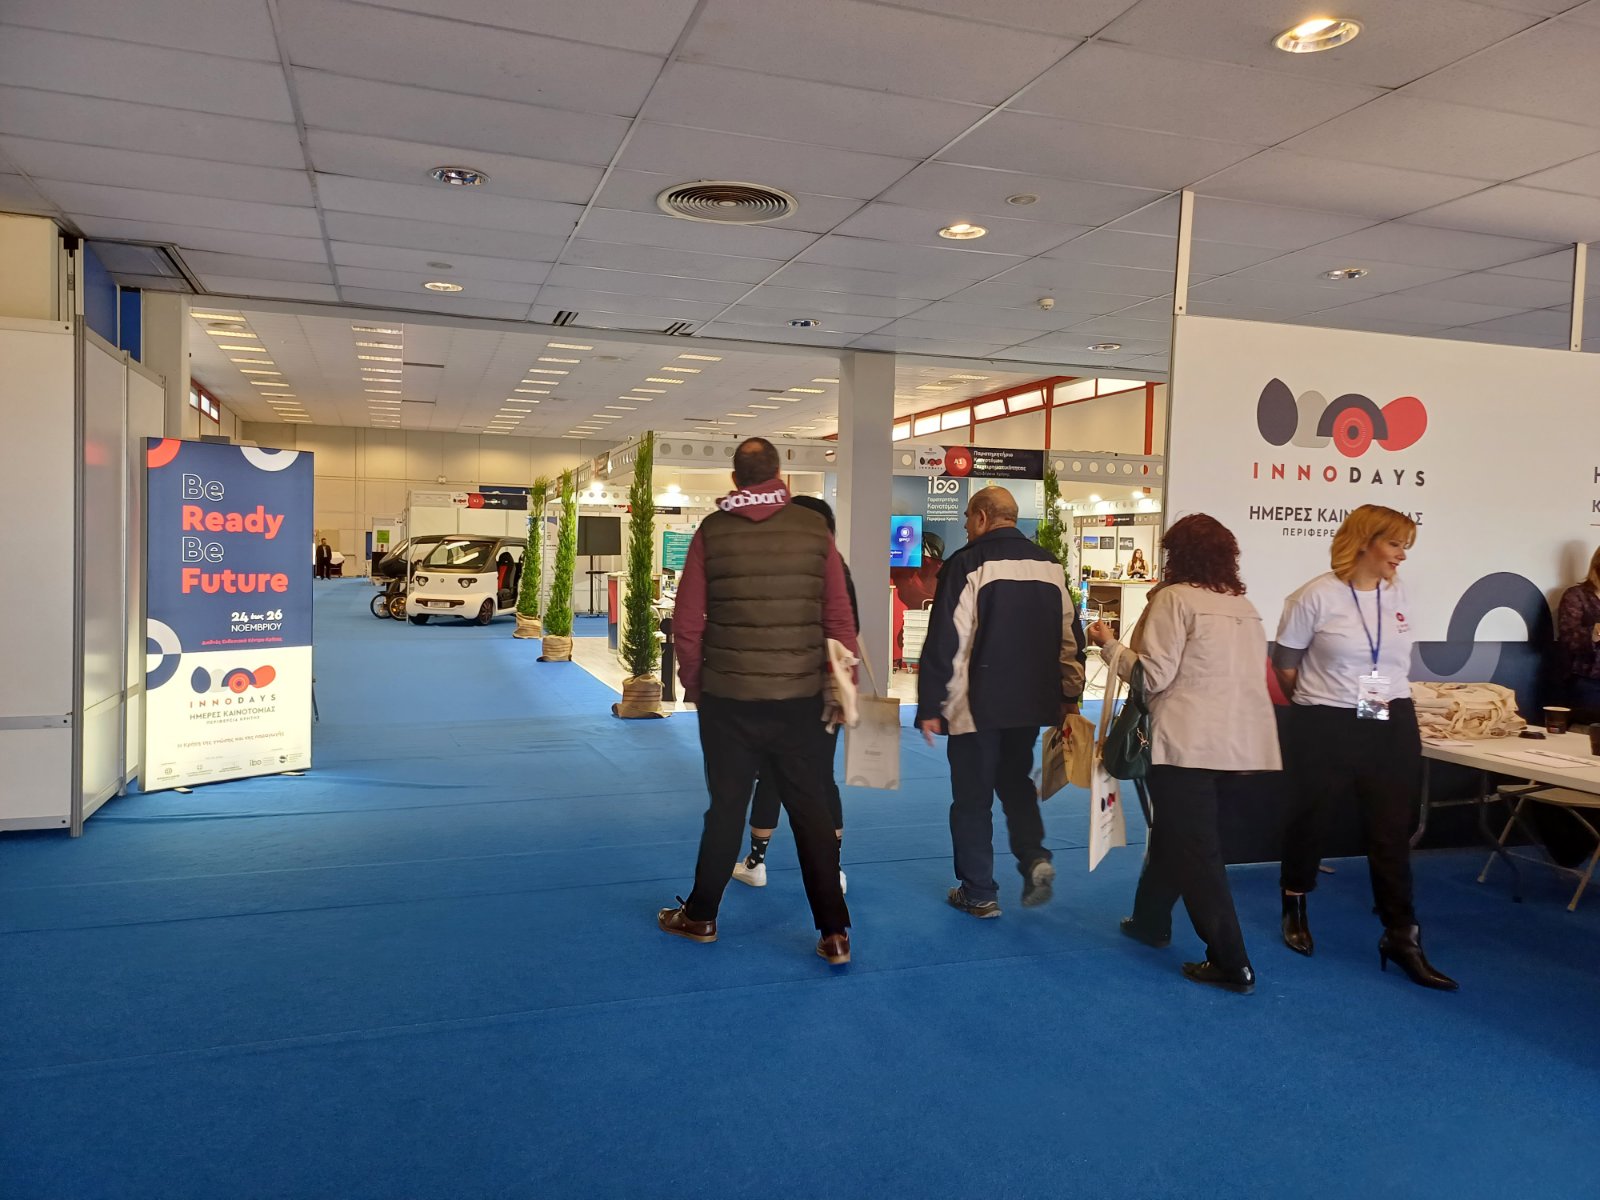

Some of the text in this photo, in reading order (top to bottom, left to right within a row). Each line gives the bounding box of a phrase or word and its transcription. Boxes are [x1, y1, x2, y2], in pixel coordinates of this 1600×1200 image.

[1253, 462, 1425, 486] INNODAYS
[182, 473, 225, 501] Be
[927, 476, 960, 494] ibo
[182, 505, 285, 540] Ready
[1249, 506, 1313, 522] ΗΜΕΡΕΣ
[1282, 527, 1337, 538] ΠΕΡΙΦΕΡΕ
[182, 537, 225, 563] Be
[182, 567, 289, 593] Future
[231, 611, 249, 622] 24
[266, 609, 283, 621] 26
[231, 623, 282, 632] ΝΟΕΜΒΡΙΟΥ
[190, 694, 276, 708] INNODAYS
[223, 706, 276, 717] ΚΑΙΝΟΤΟΜΙΑΣ
